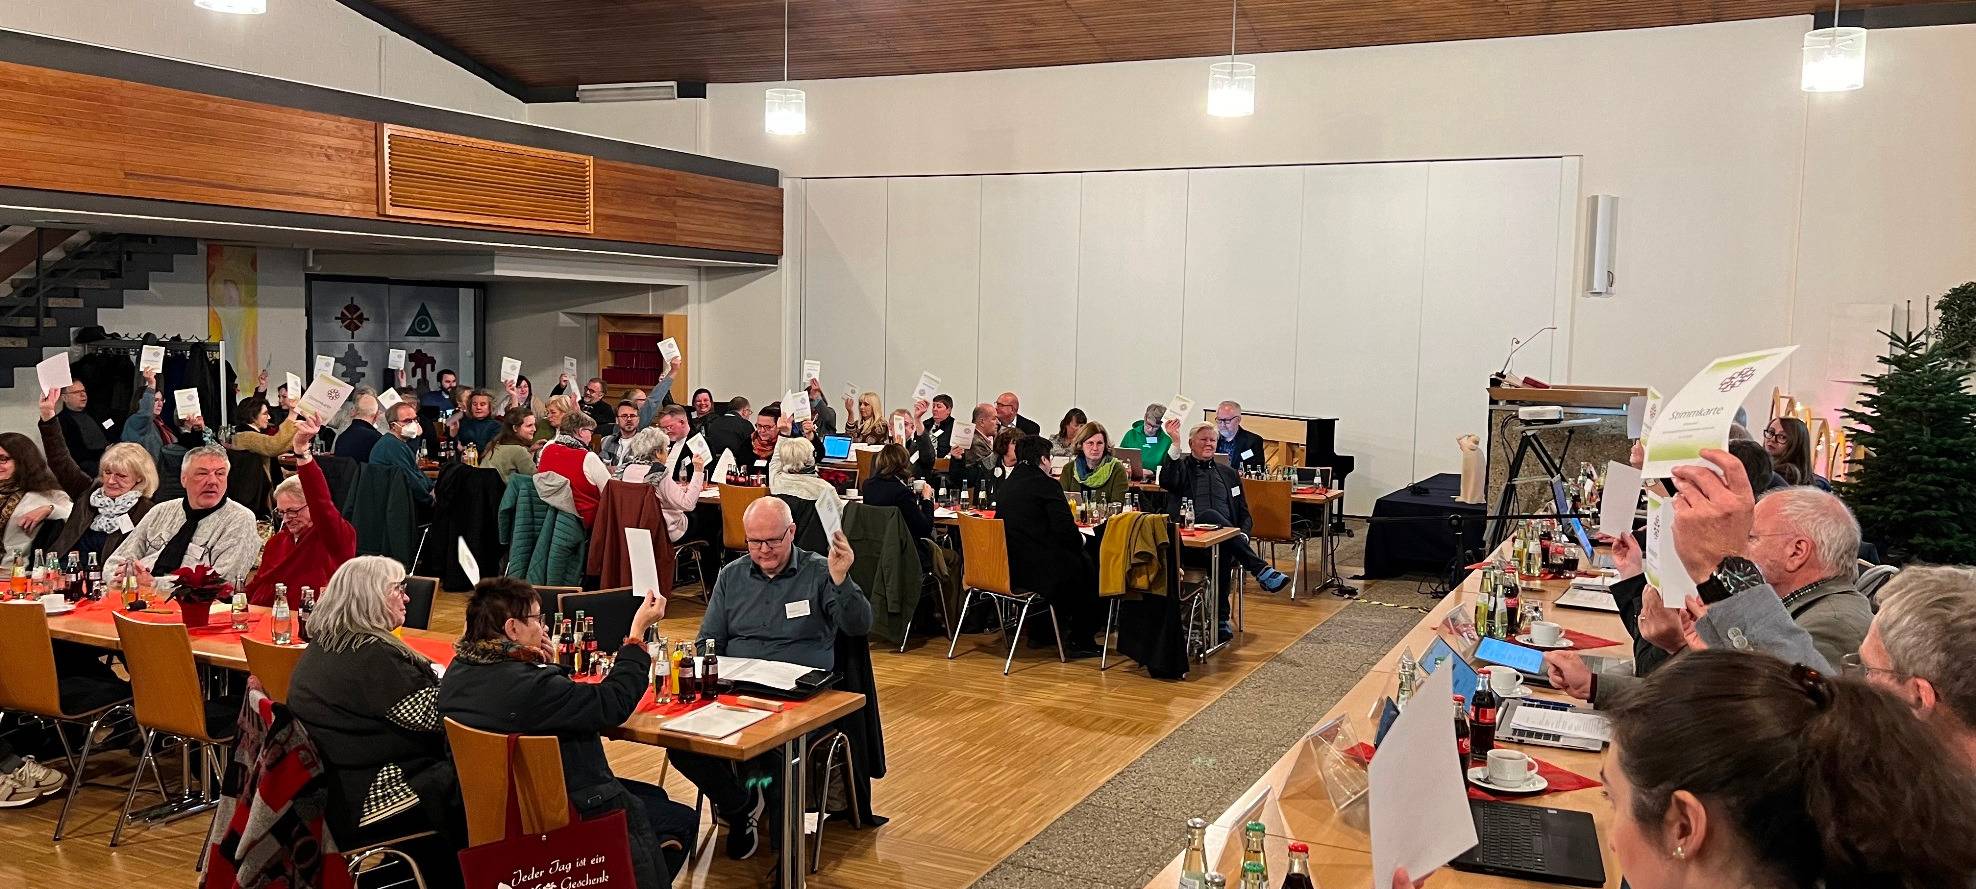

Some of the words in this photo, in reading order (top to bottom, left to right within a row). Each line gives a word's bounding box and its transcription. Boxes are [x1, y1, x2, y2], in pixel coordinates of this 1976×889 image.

[1669, 406, 1724, 420] Stimmkarte
[511, 866, 544, 887] Jeder
[576, 857, 587, 868] ist
[590, 854, 605, 865] ein
[560, 869, 609, 889] Geschenk
